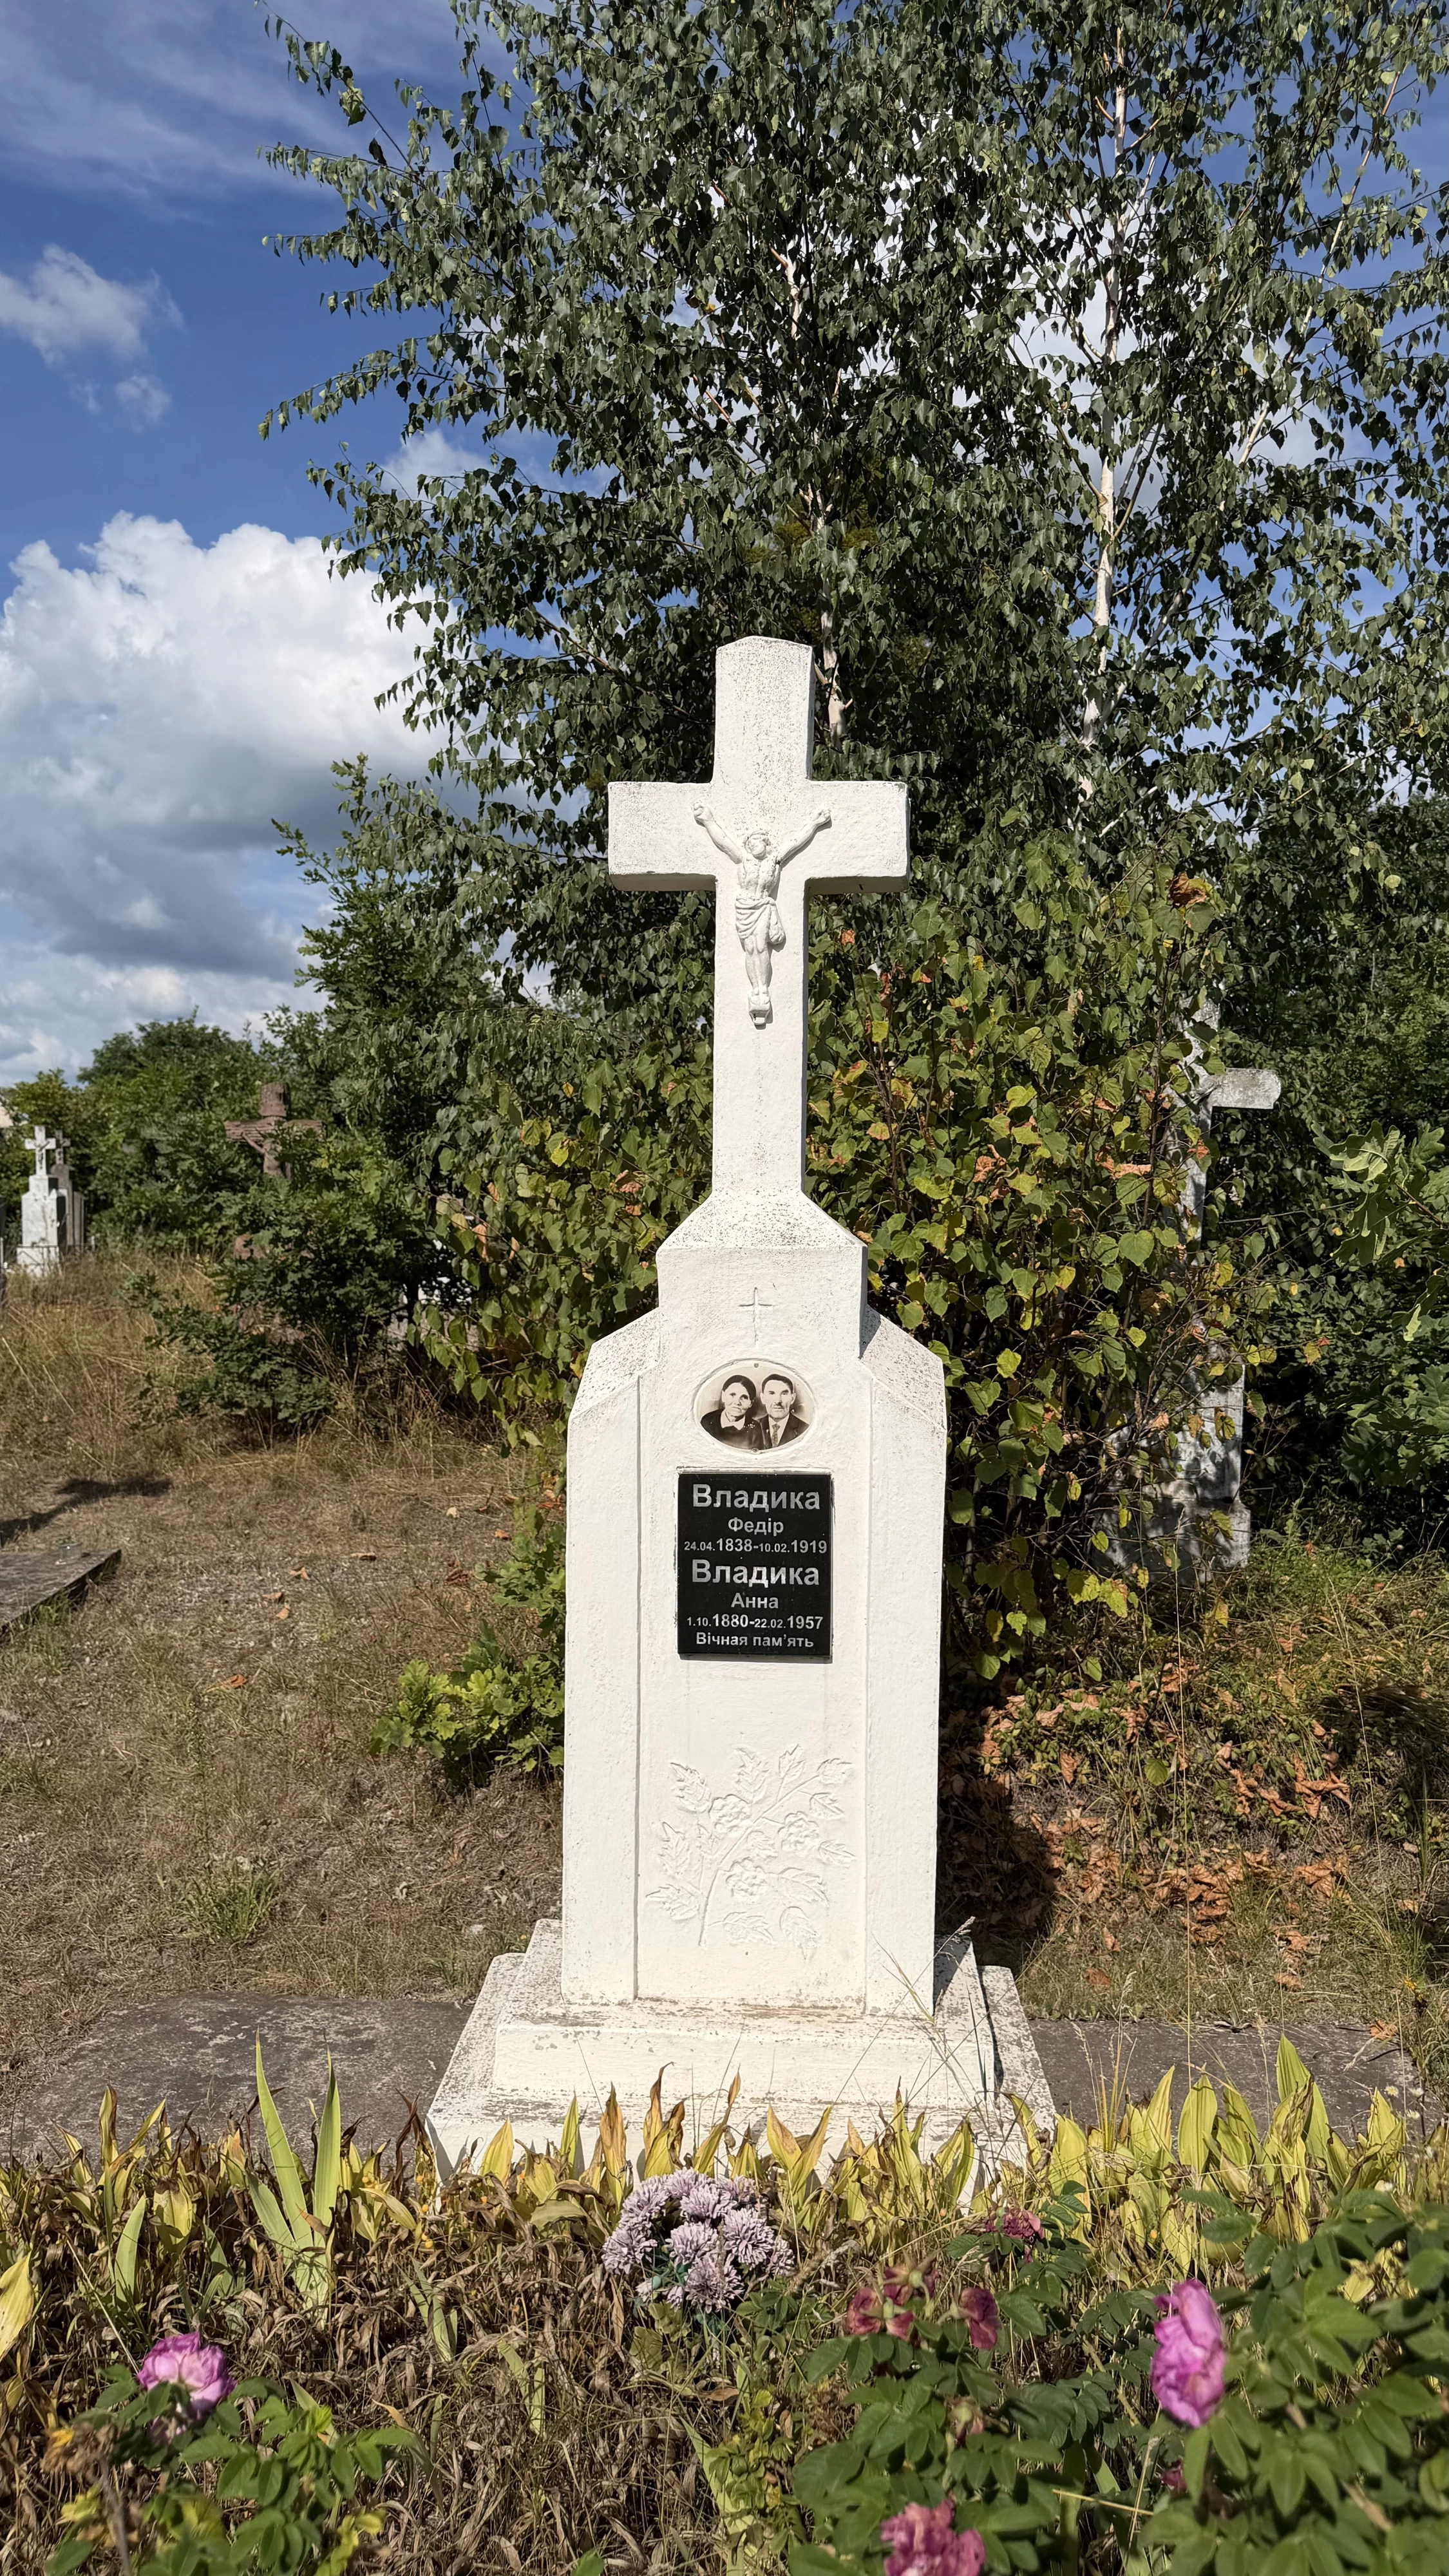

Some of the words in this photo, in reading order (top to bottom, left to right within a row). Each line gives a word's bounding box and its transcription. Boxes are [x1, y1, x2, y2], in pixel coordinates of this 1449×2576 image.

[692, 1484, 820, 1512] Владика
[728, 1517, 784, 1537] Федір
[692, 1559, 820, 1588] Владика
[731, 1593, 779, 1609] Анна
[696, 1633, 748, 1646] Вічная
